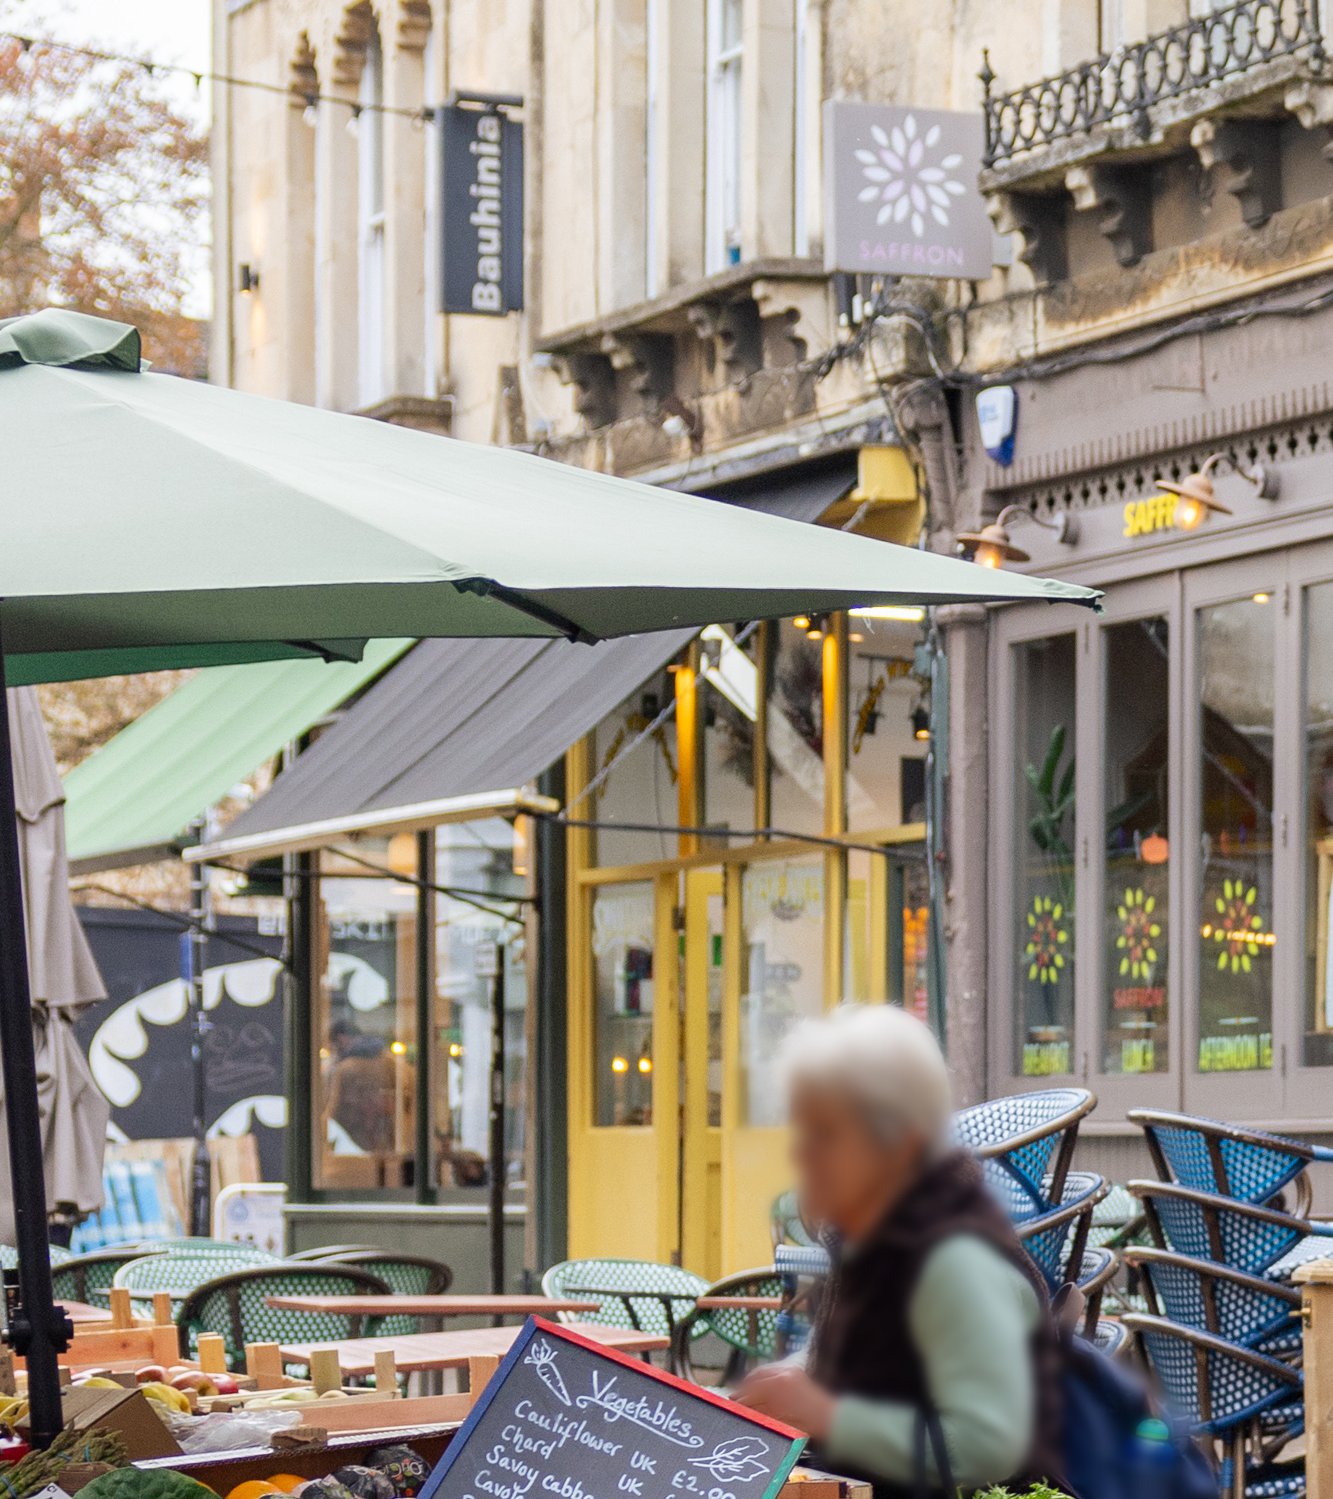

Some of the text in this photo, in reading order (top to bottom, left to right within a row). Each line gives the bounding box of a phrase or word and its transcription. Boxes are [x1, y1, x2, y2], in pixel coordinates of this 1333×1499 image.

[470, 115, 501, 311] Bauhinia
[859, 240, 964, 267] SAFFRON
[1123, 492, 1180, 537] SAFFR
[514, 1400, 623, 1457] Cauliflower
[629, 1450, 658, 1476] UK
[591, 1369, 693, 1439] Vegetables
[485, 1444, 540, 1492] Savoy
[501, 1424, 557, 1460] Chard
[617, 1473, 645, 1497] UK
